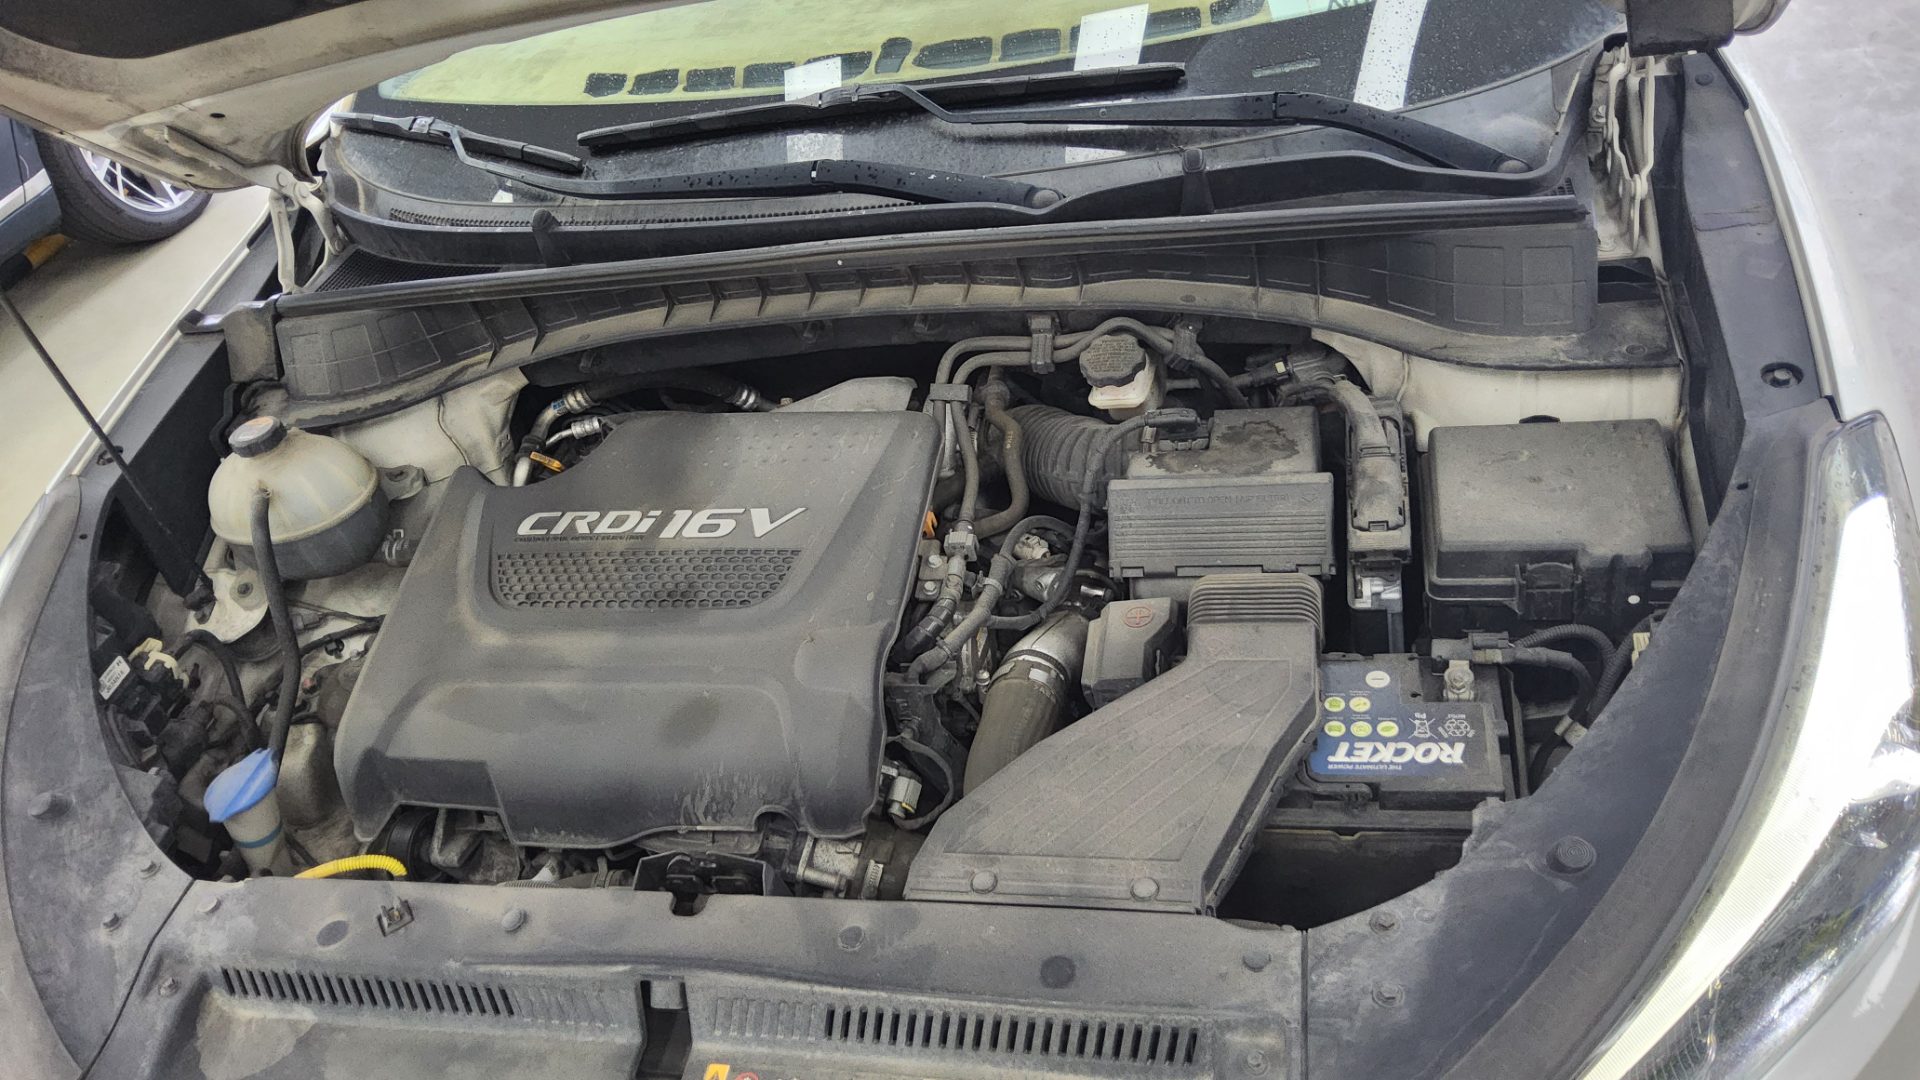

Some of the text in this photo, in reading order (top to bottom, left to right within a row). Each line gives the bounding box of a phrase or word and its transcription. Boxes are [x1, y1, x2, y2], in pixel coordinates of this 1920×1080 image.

[516, 507, 808, 539] CRDi 16V
[1326, 741, 1466, 764] ROCKET
